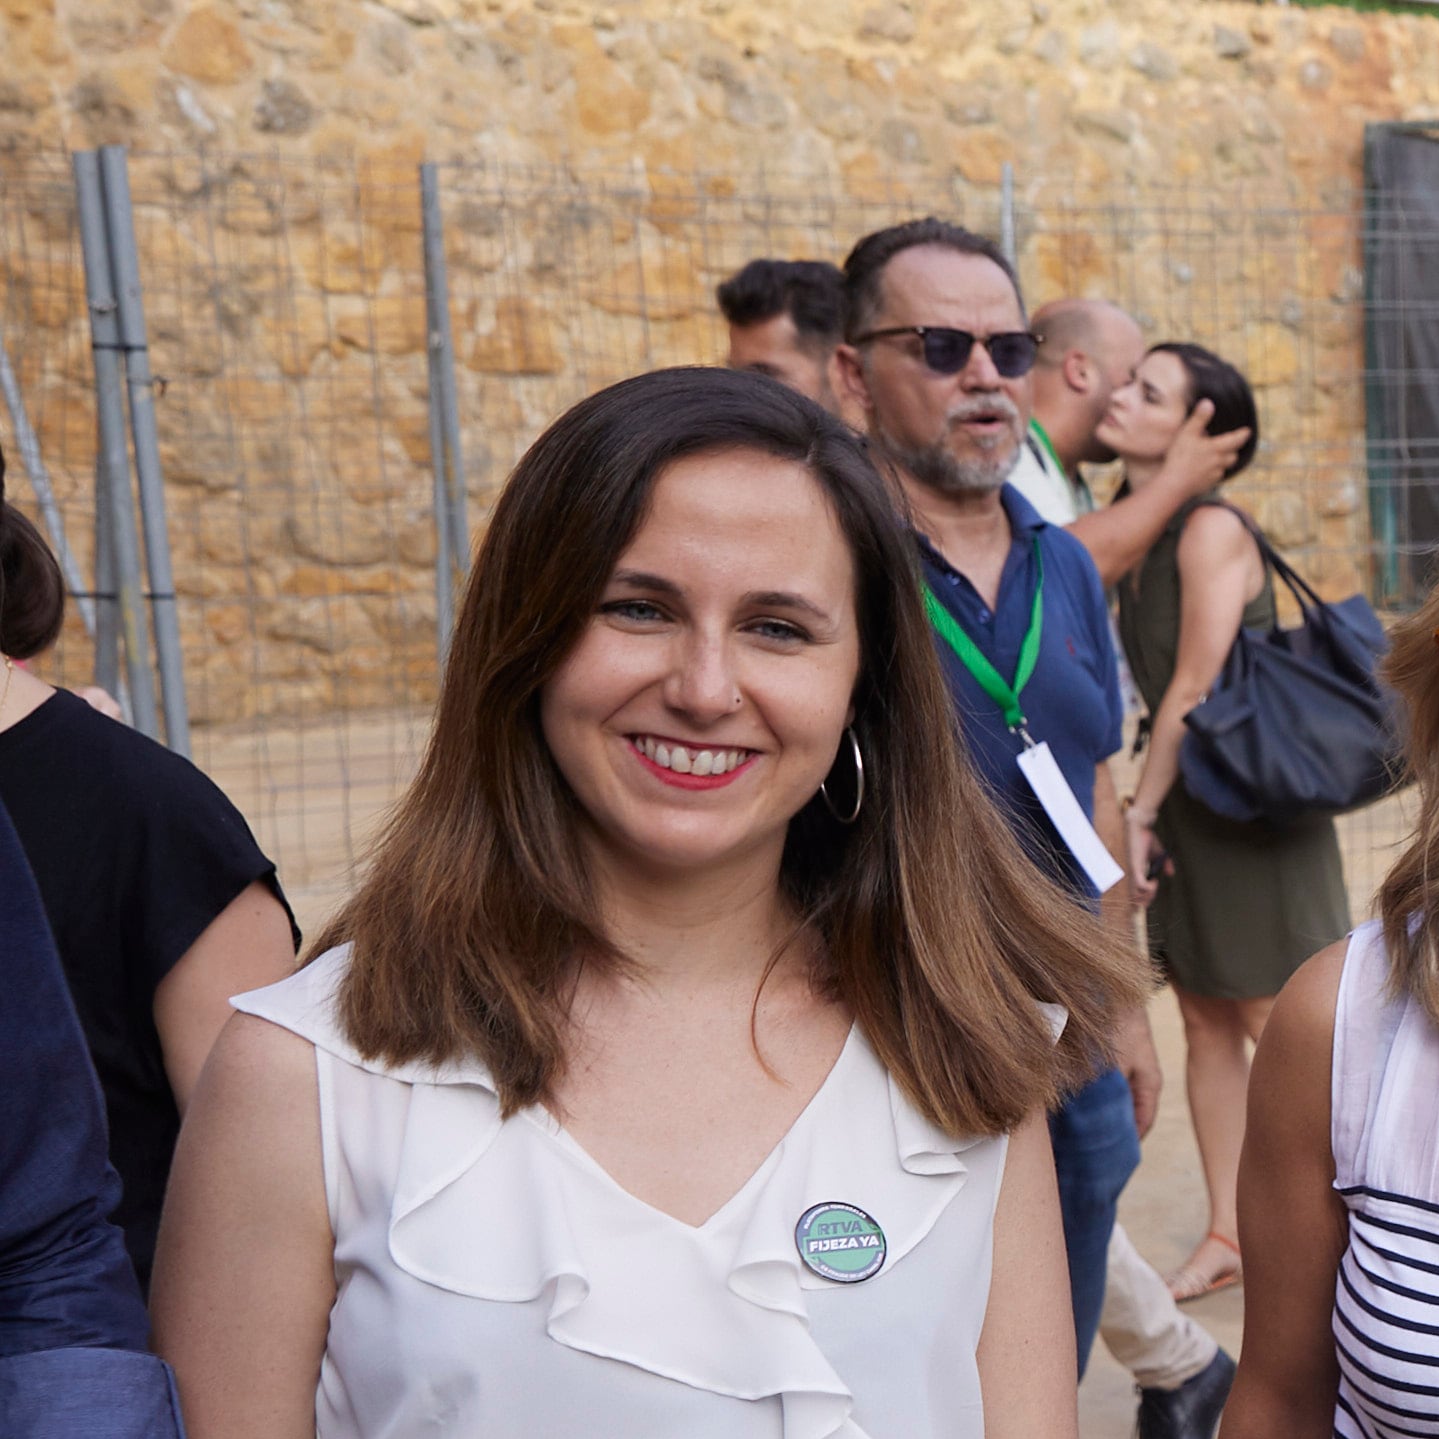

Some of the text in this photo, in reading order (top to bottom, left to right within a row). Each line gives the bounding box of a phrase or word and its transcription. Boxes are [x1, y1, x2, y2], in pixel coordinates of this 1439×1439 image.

[818, 1220, 862, 1235] RTVA
[809, 1235, 879, 1252] FIJEZA YA
